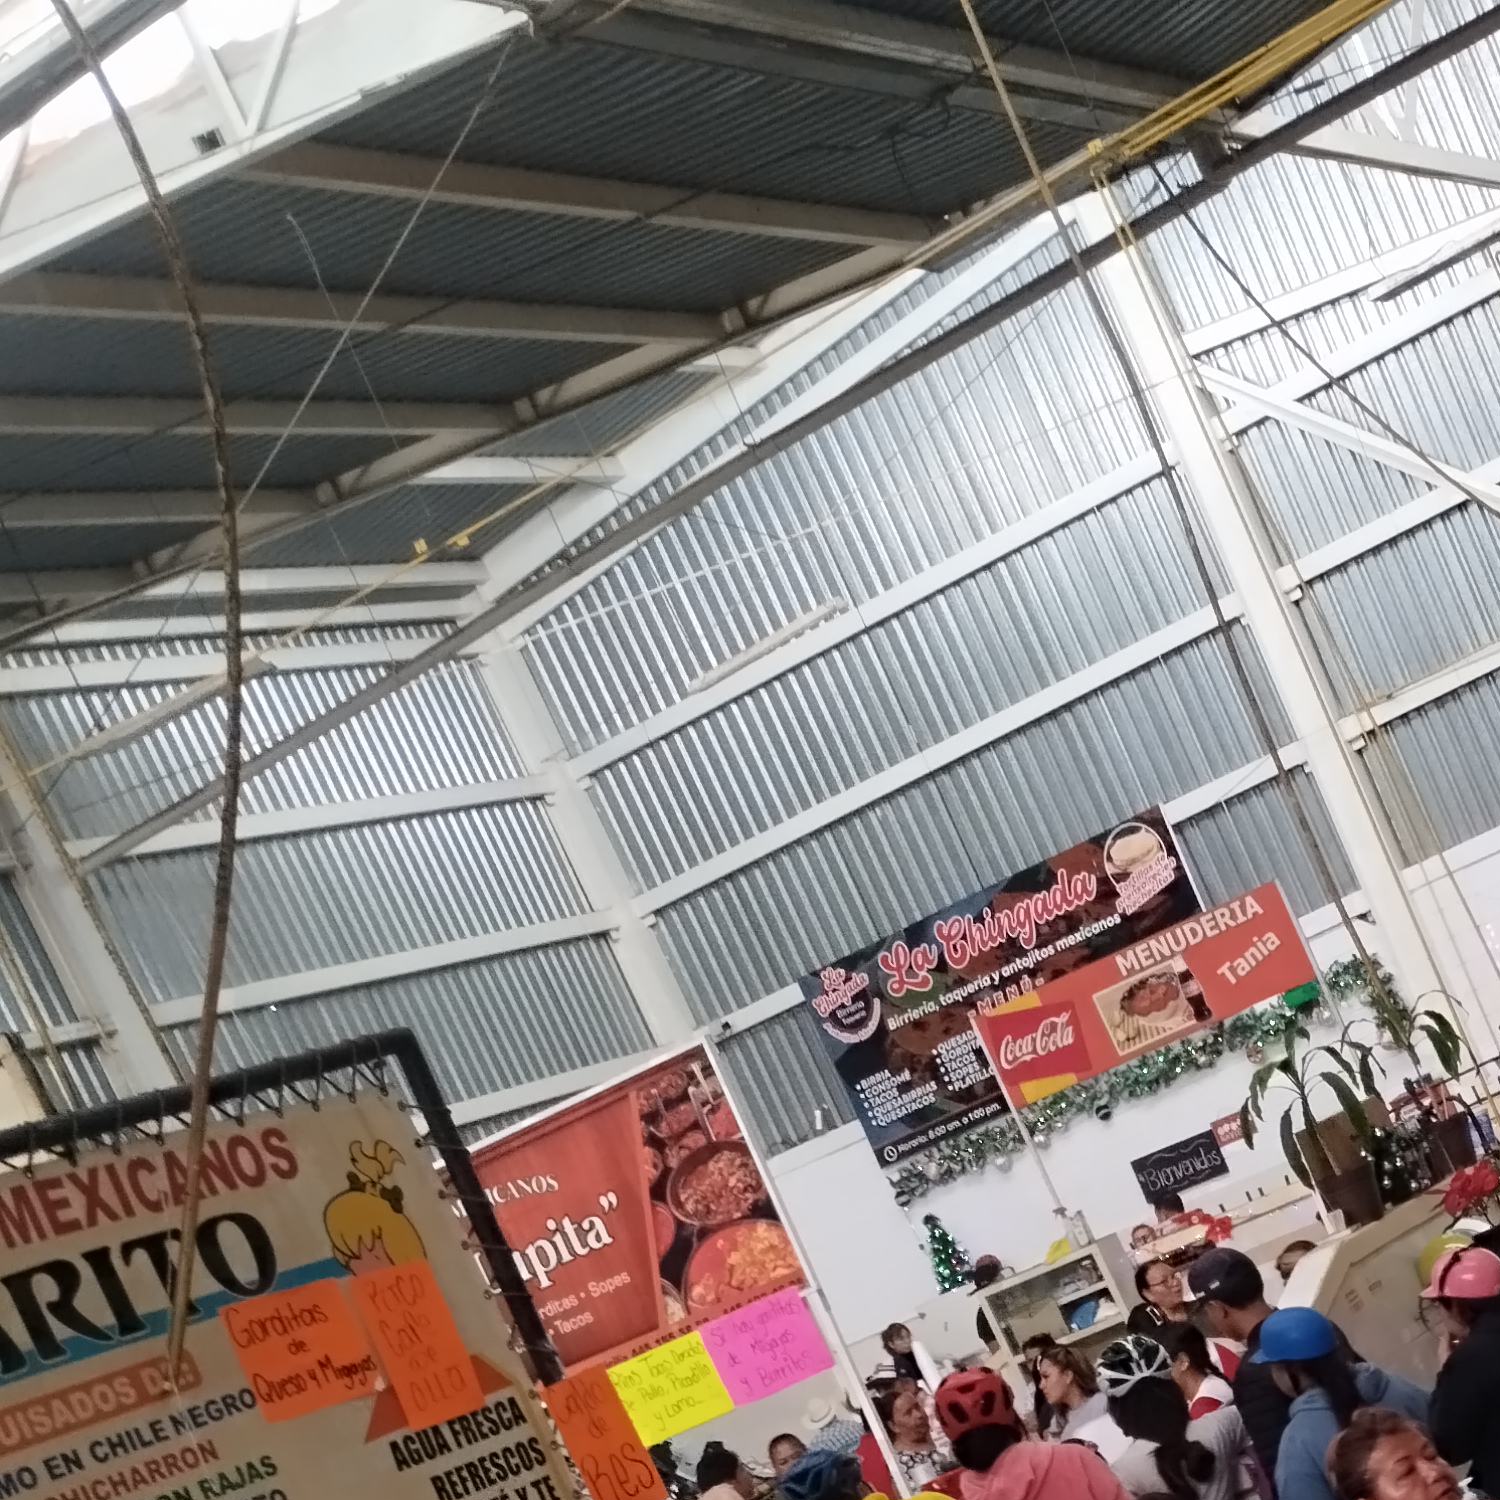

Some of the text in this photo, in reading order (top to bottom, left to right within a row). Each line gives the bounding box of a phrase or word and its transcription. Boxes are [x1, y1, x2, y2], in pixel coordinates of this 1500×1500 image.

[878, 941, 947, 997] La
[933, 868, 1096, 969] Chingada
[991, 971, 1000, 984] y
[1001, 945, 1055, 977] antojitos
[1055, 914, 1121, 951] mexicanos
[1115, 896, 1264, 976] MENUDERIA
[1217, 932, 1280, 984] Tania
[977, 975, 1033, 1014] MENÚ
[1000, 1011, 1074, 1069] Coca-Cola
[860, 1070, 892, 1089] BIRRIA
[861, 1066, 912, 1099] CONSOMÉ
[945, 1052, 978, 1074] TACOS
[948, 1061, 979, 1082] SOPES
[868, 1087, 901, 1108] TACOS
[874, 1080, 938, 1116] QUESABIRRIAS
[877, 1093, 935, 1127] QUESATACOS
[0, 1128, 298, 1248] MEXICANOS
[1144, 1147, 1221, 1191] Bienvenidos
[588, 1272, 630, 1297] Sopes
[220, 1302, 328, 1349] Gorditas
[554, 1312, 593, 1334] Tacos
[287, 1338, 310, 1355] de
[253, 1366, 307, 1403] Queso
[307, 1369, 321, 1388] y
[43, 1449, 84, 1481] EN
[89, 1419, 170, 1463] CHILE
[169, 1388, 257, 1435] NEGRO
[390, 1397, 527, 1471] AGUA FRESCA
[198, 1456, 277, 1500] RAJAS
